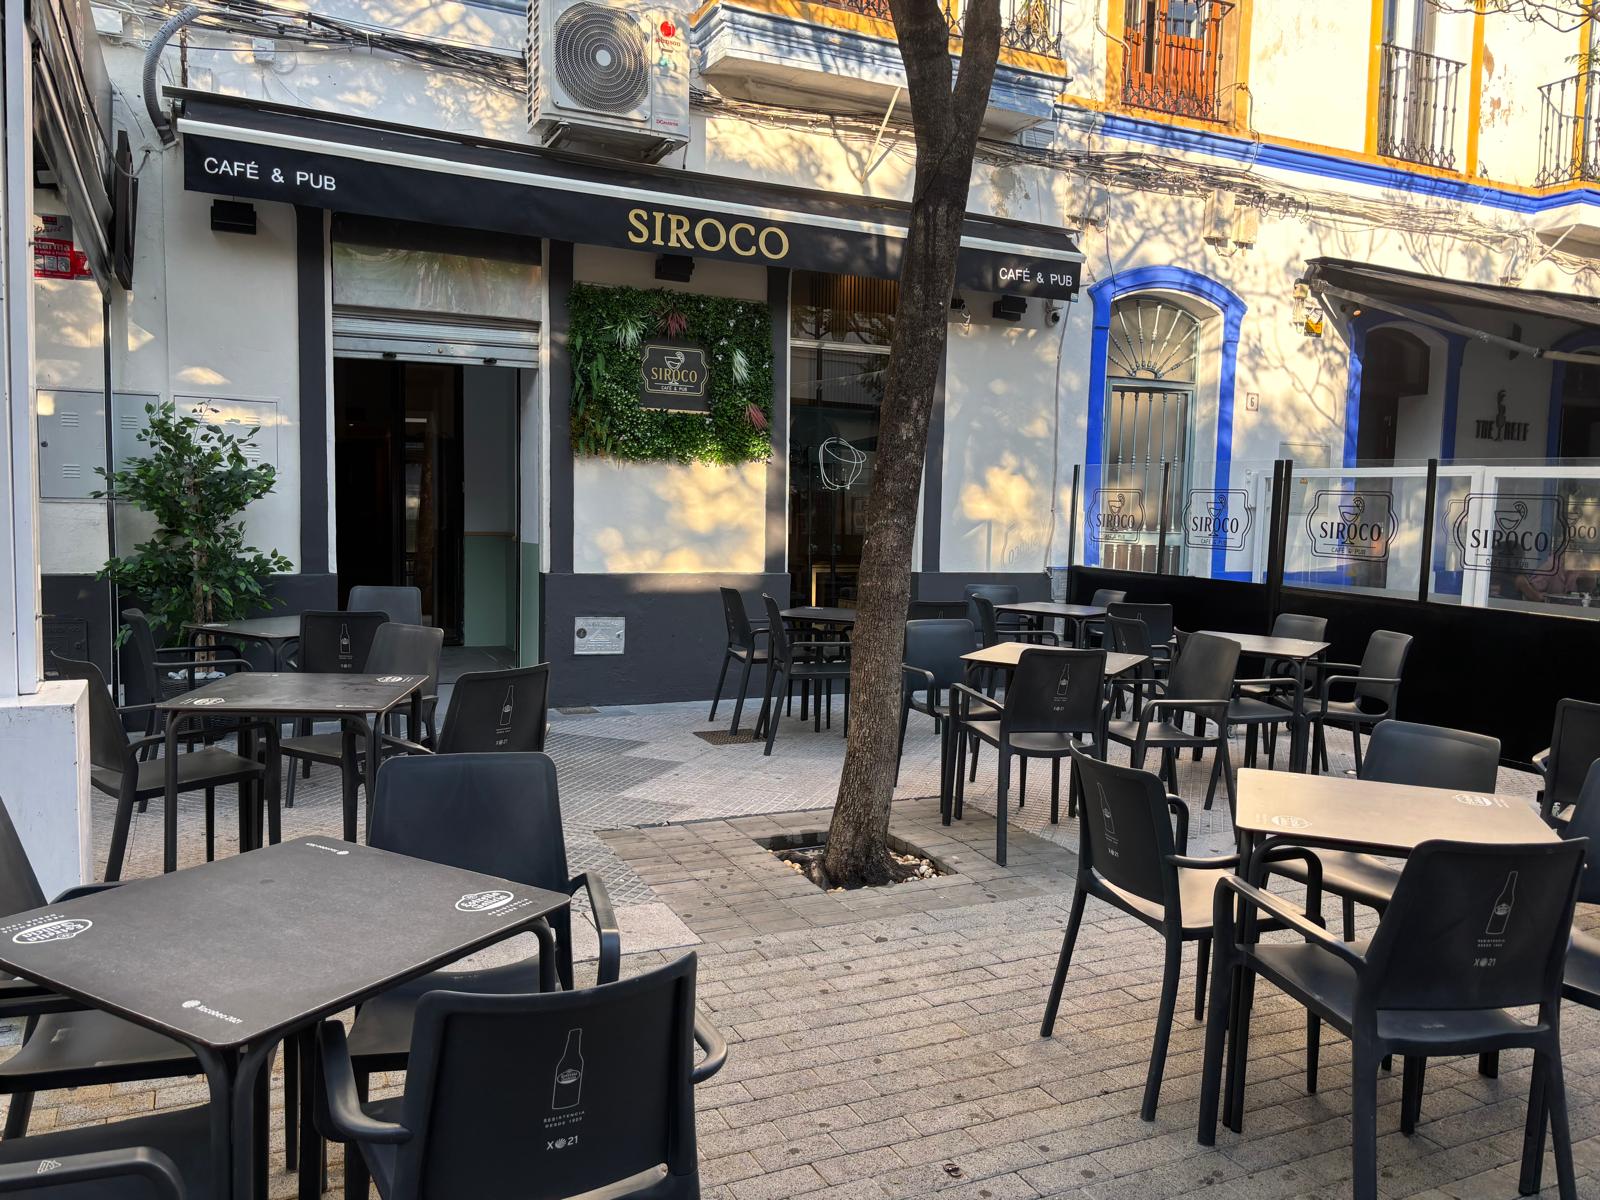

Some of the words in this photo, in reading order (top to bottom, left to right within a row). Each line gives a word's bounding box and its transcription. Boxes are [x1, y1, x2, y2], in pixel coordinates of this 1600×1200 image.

[204, 157, 259, 180] CAFÉ
[271, 168, 285, 183] &
[296, 171, 336, 191] PUB
[627, 208, 789, 260] SIROCO
[999, 267, 1031, 282] CAFÉ
[1036, 272, 1045, 284] &
[1050, 273, 1073, 287] PUB
[651, 366, 698, 383] SIROCO
[1095, 513, 1135, 529] SIROCO
[1191, 516, 1239, 534] SIROCO
[1319, 521, 1381, 542] SIROCO
[1470, 528, 1549, 553] SIROCO
